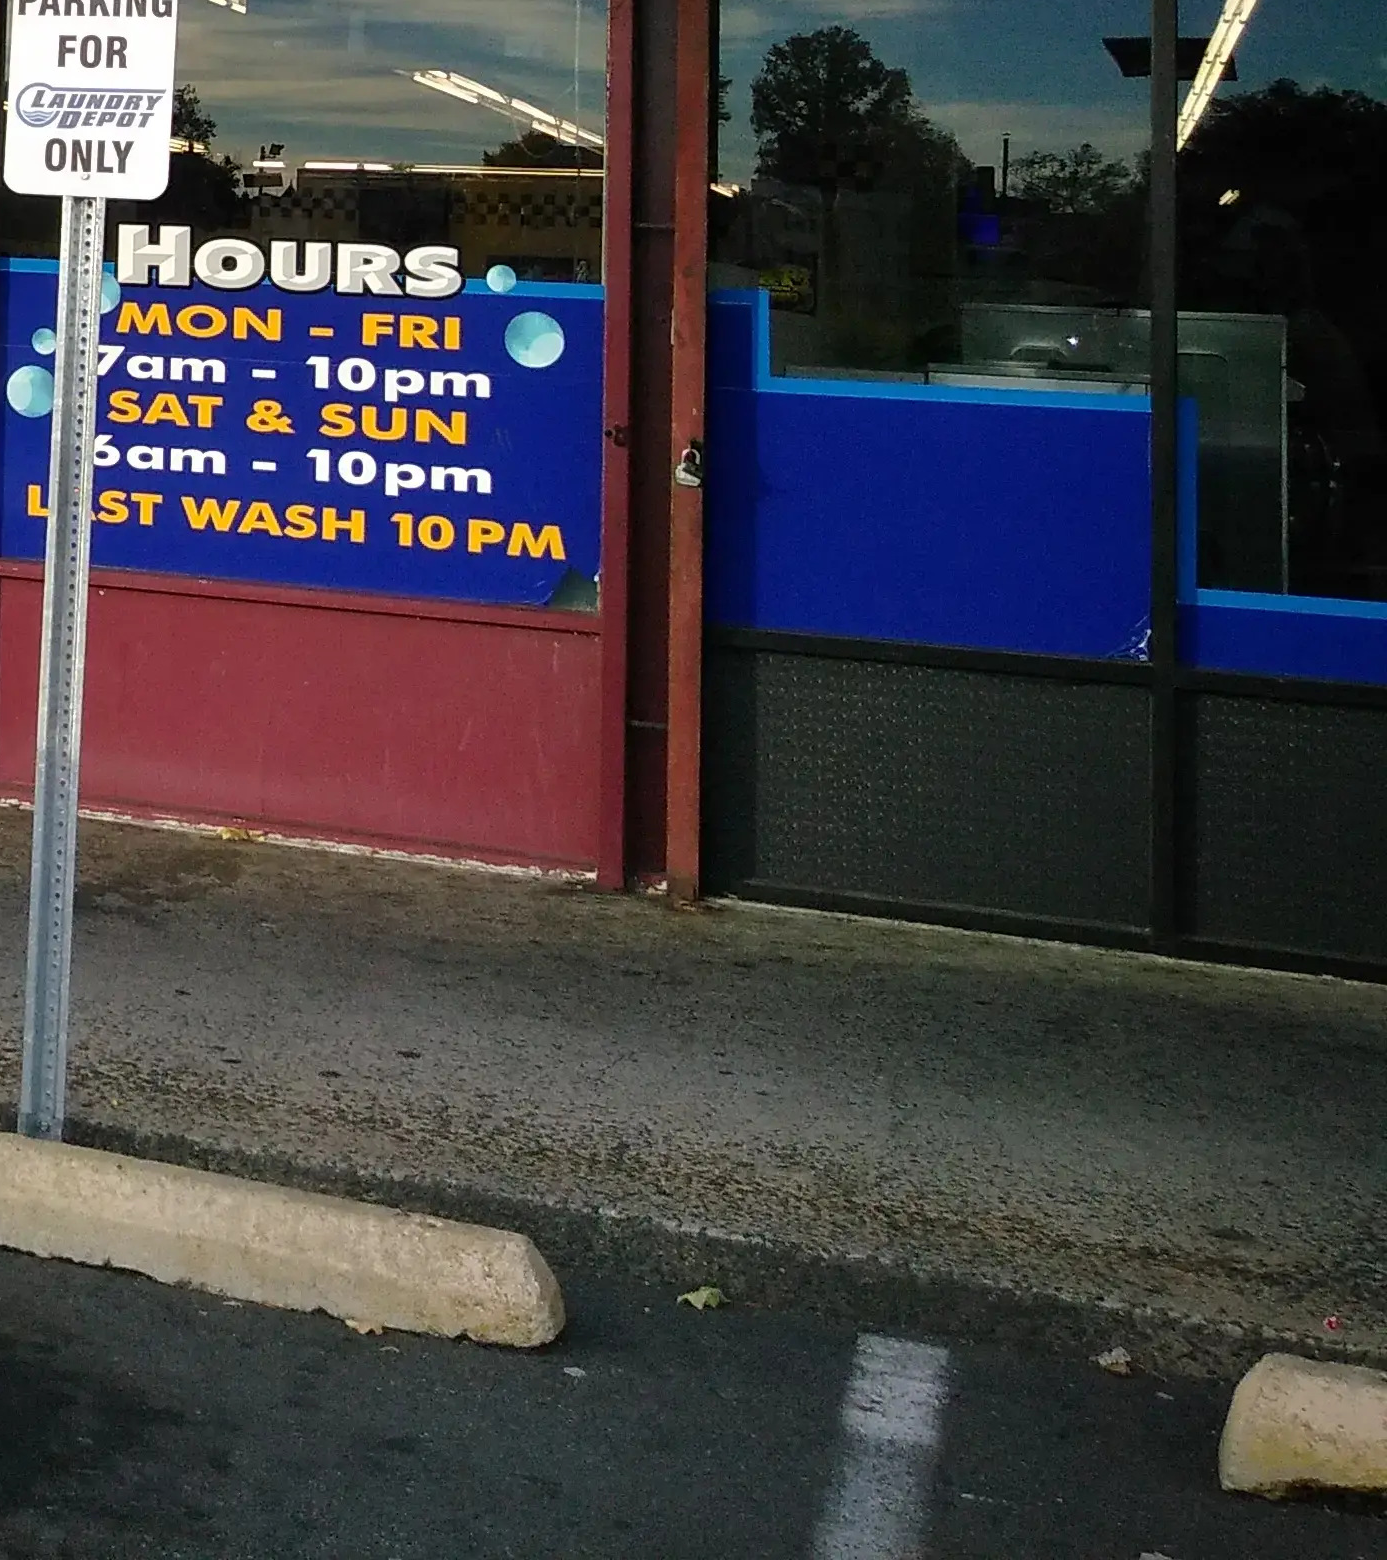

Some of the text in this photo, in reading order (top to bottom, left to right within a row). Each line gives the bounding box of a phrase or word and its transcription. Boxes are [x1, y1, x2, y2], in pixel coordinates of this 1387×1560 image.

[56, 35, 128, 69] FOR
[31, 89, 163, 111] LAUNDRY
[57, 110, 155, 128] DEPOT
[44, 137, 134, 174] ONLY
[117, 223, 463, 297] HOURS
[116, 302, 283, 342] MON
[361, 314, 462, 351] FRI
[97, 344, 227, 383] 7am
[306, 357, 491, 402] 10pm
[107, 390, 468, 445] SAT & SUN
[93, 434, 227, 476] 6am
[306, 448, 492, 496] 10pm
[27, 484, 164, 527] LST
[181, 496, 365, 543] WASH
